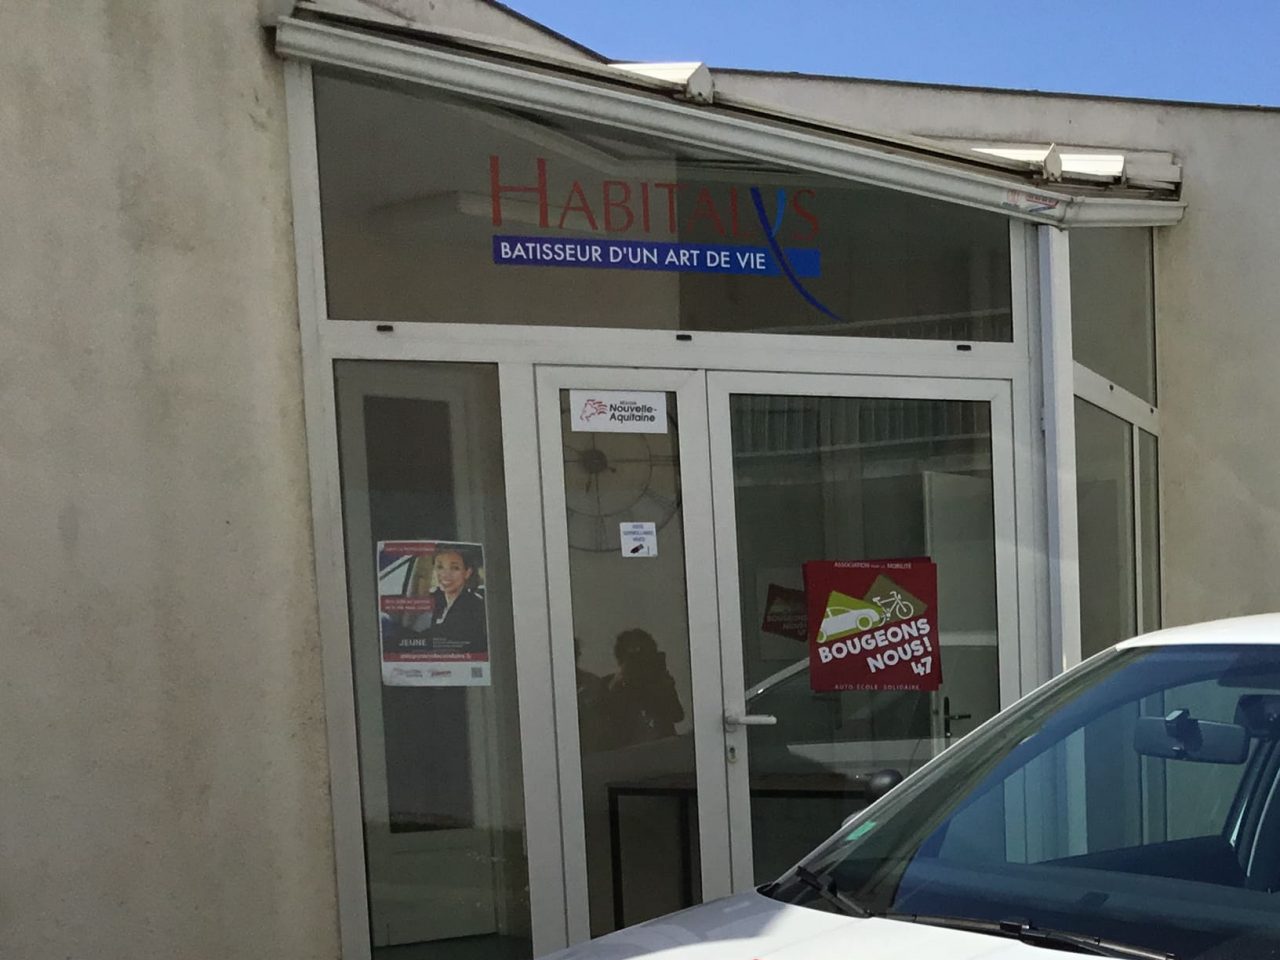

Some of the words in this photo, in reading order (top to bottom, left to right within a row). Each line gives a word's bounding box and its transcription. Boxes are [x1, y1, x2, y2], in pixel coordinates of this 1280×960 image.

[500, 242, 602, 263] BATISSEUR
[609, 246, 658, 265] D'UN
[665, 248, 700, 266] ART
[706, 250, 730, 268] DE
[736, 252, 766, 270] VIE
[609, 412, 656, 424] Aquitaine
[818, 618, 931, 664] BOUGEONS
[910, 656, 933, 677] 47
